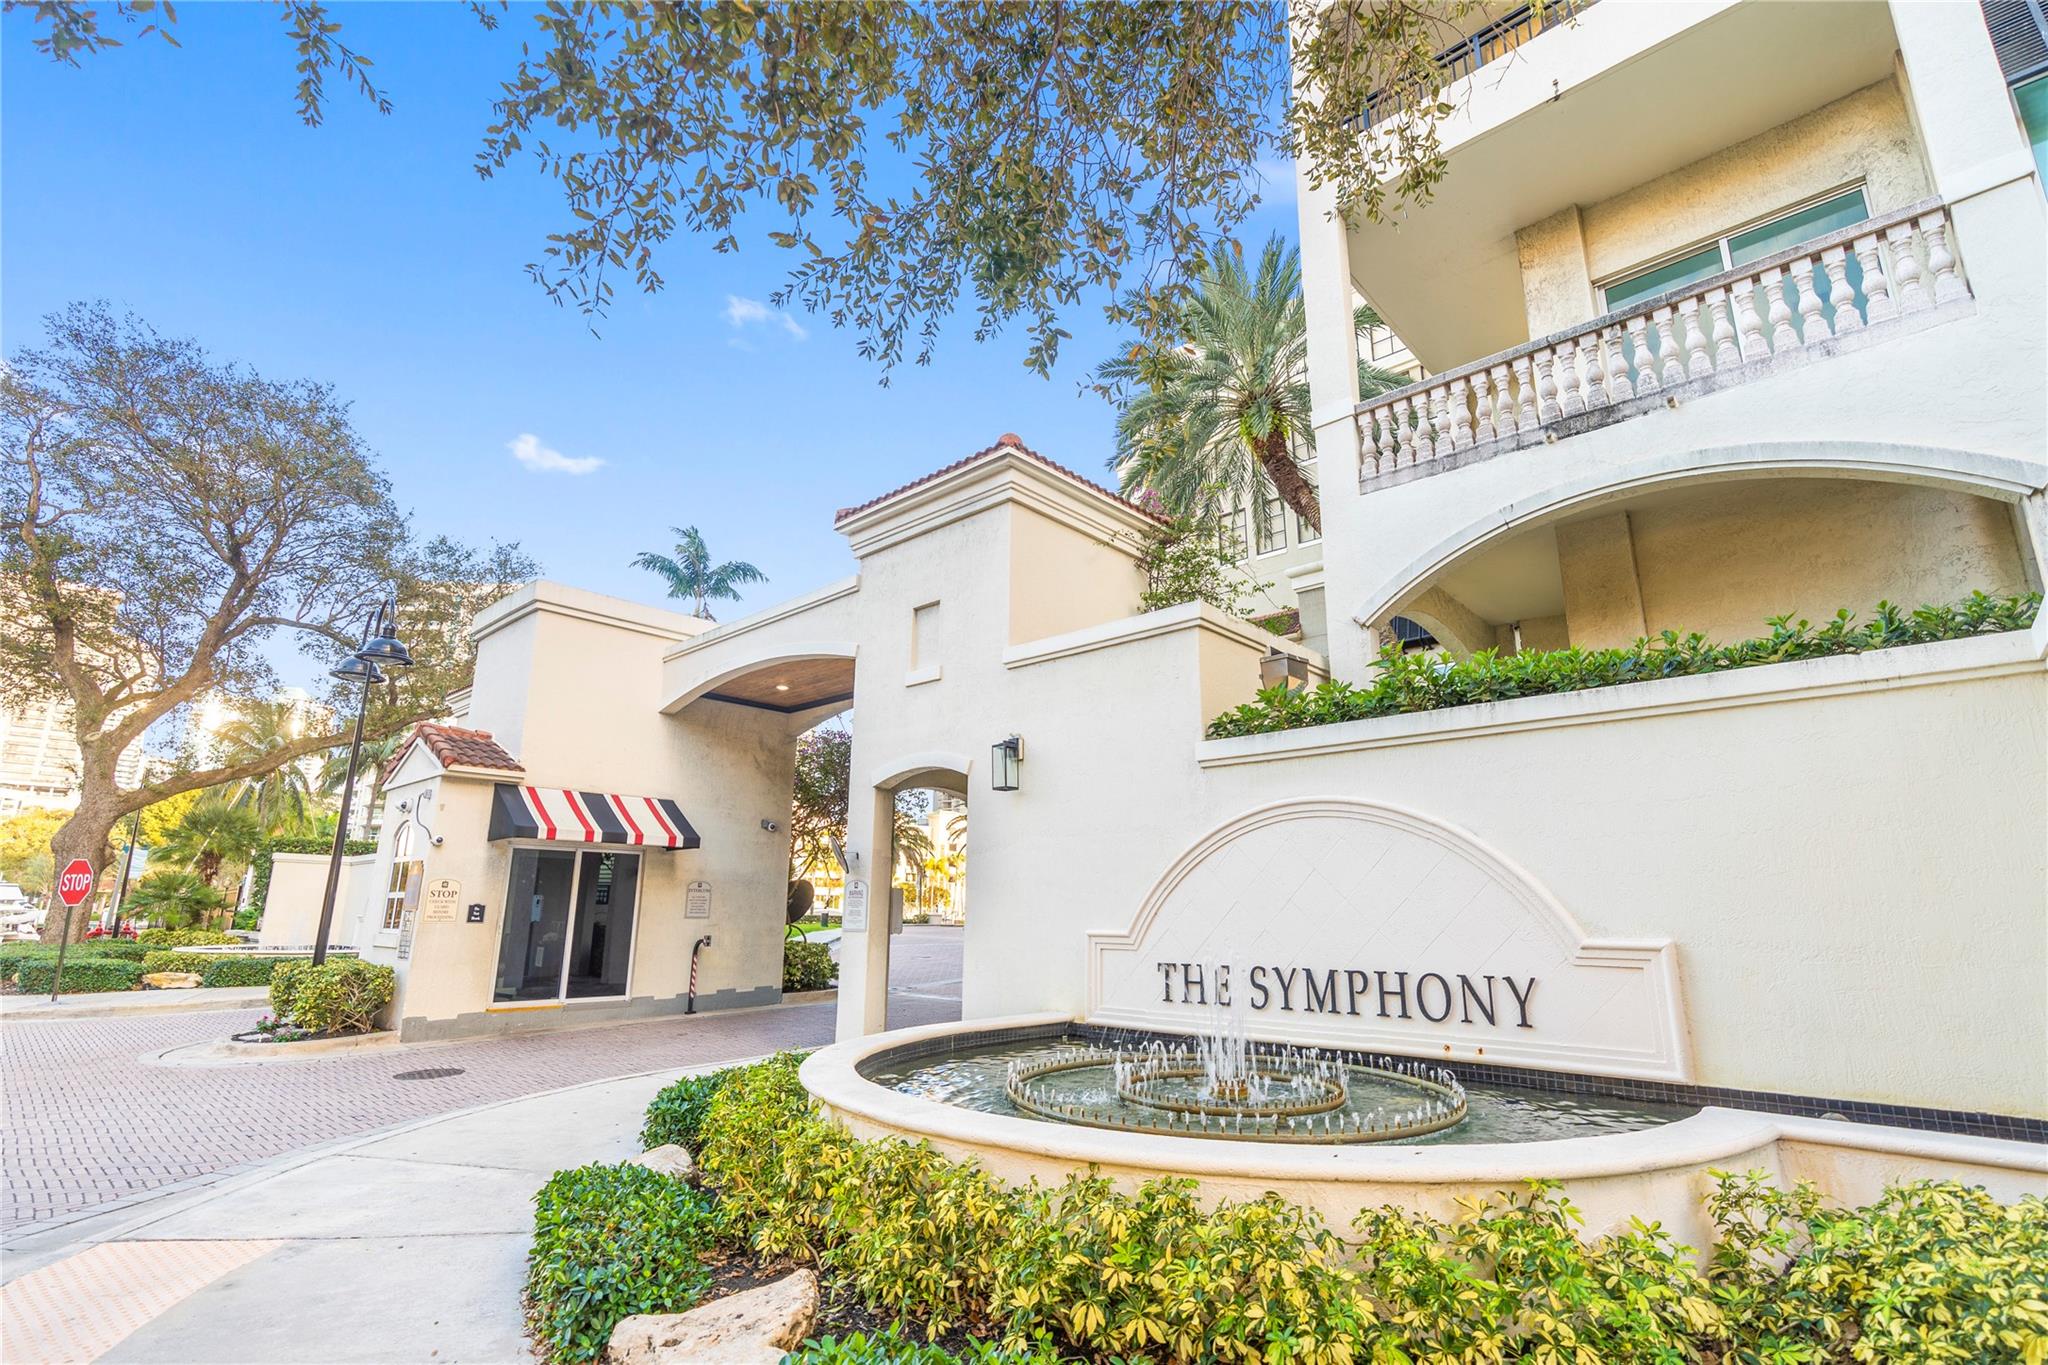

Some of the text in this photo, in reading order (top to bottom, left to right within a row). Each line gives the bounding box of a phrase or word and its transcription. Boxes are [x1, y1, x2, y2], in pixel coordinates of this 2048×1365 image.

[62, 874, 91, 892] STOP
[430, 890, 458, 898] STOP
[1157, 962, 1536, 1028] THE SYMPHONY
